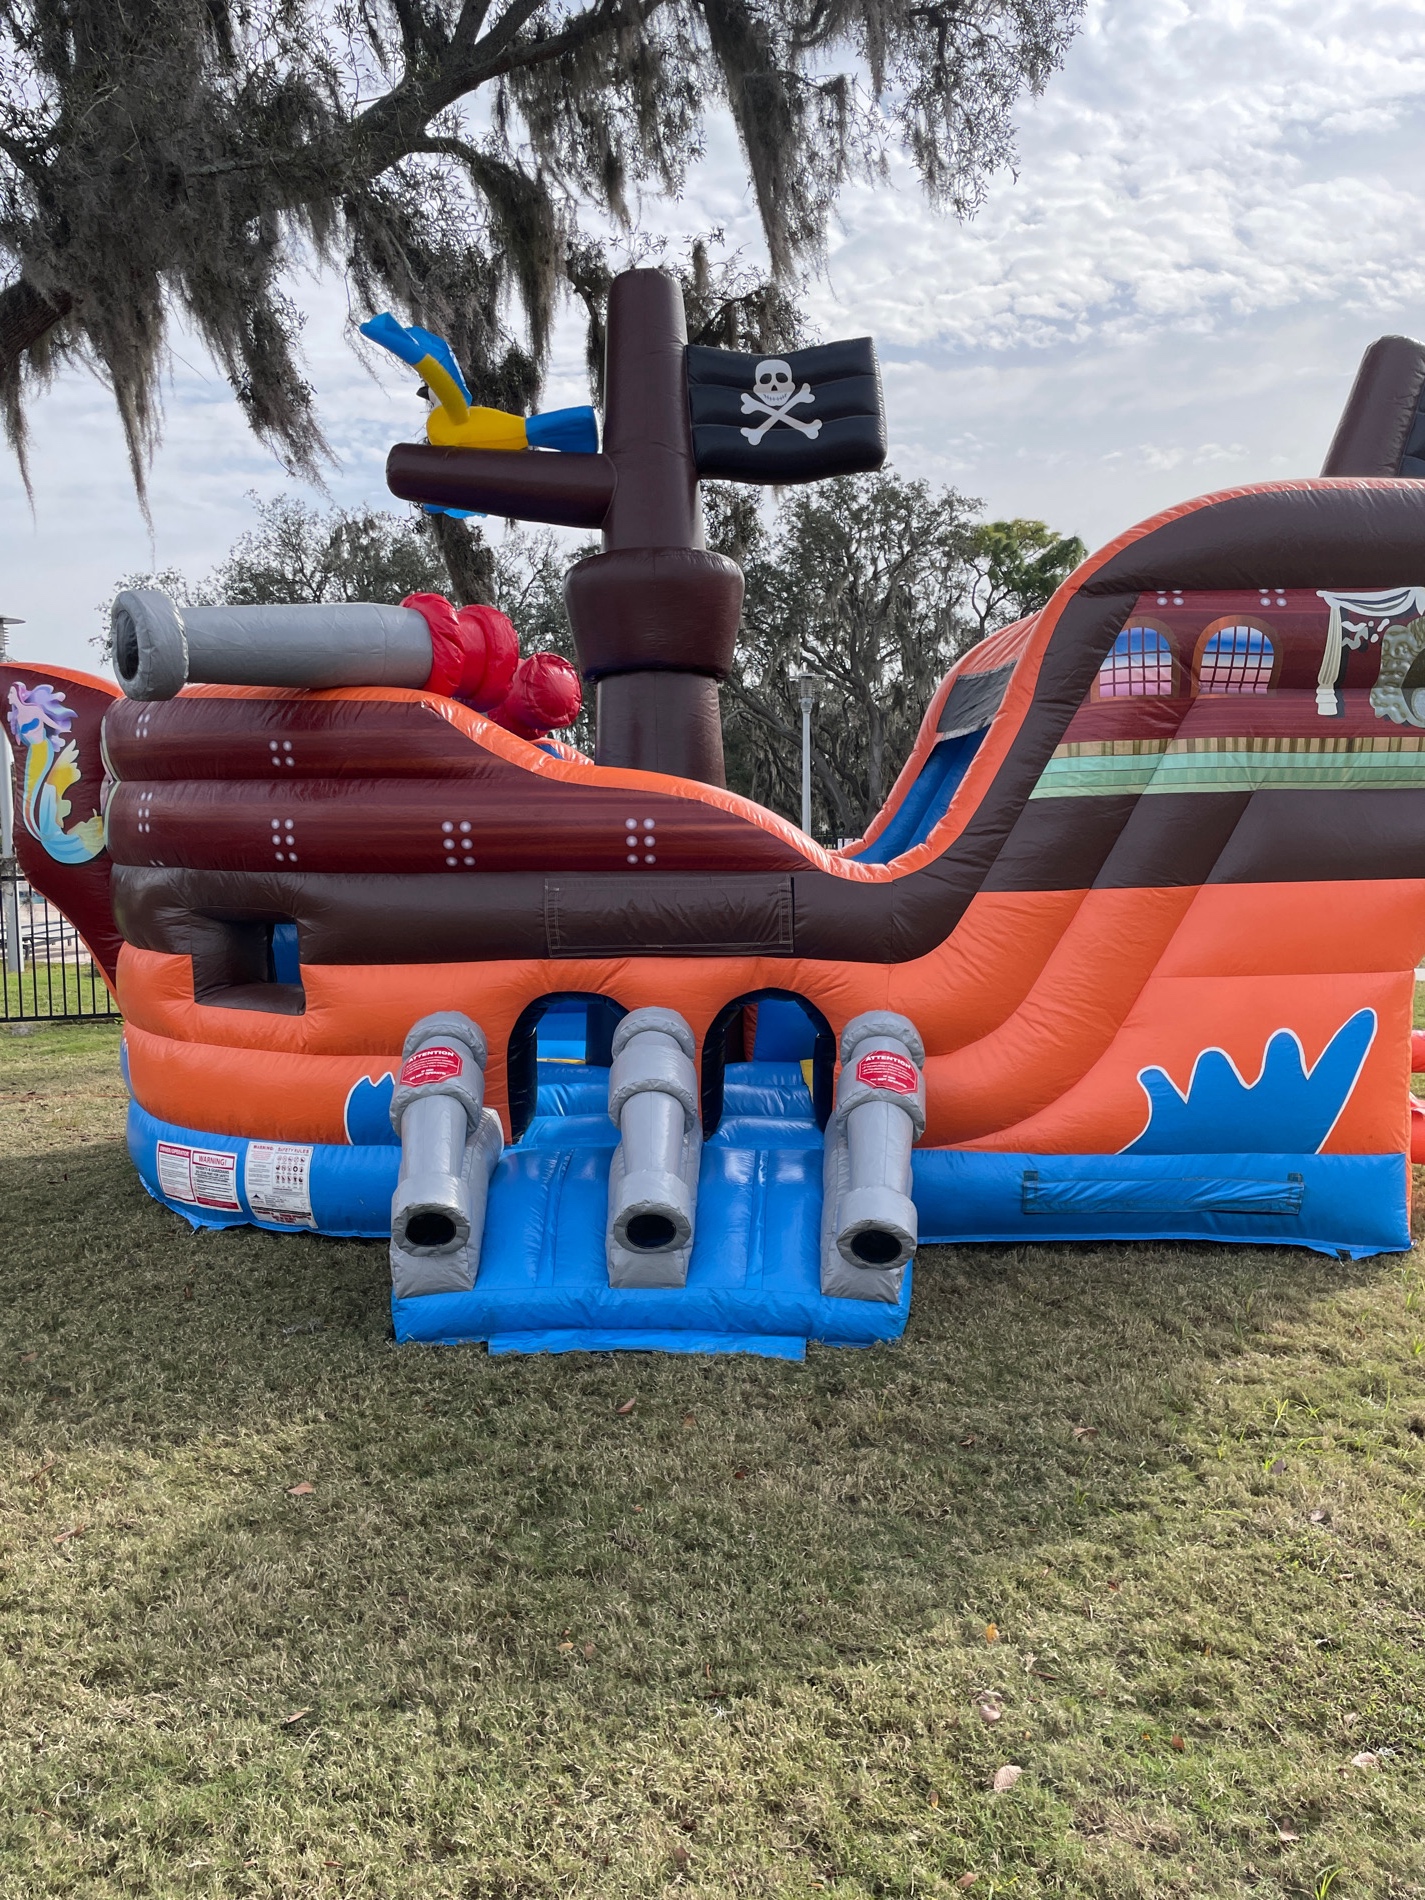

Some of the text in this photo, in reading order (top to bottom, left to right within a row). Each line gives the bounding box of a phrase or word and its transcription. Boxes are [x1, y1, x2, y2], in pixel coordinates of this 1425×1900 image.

[408, 1050, 454, 1062] ATTENTION
[866, 1056, 911, 1069] ATTENTION
[198, 1155, 227, 1166] WARNING!
